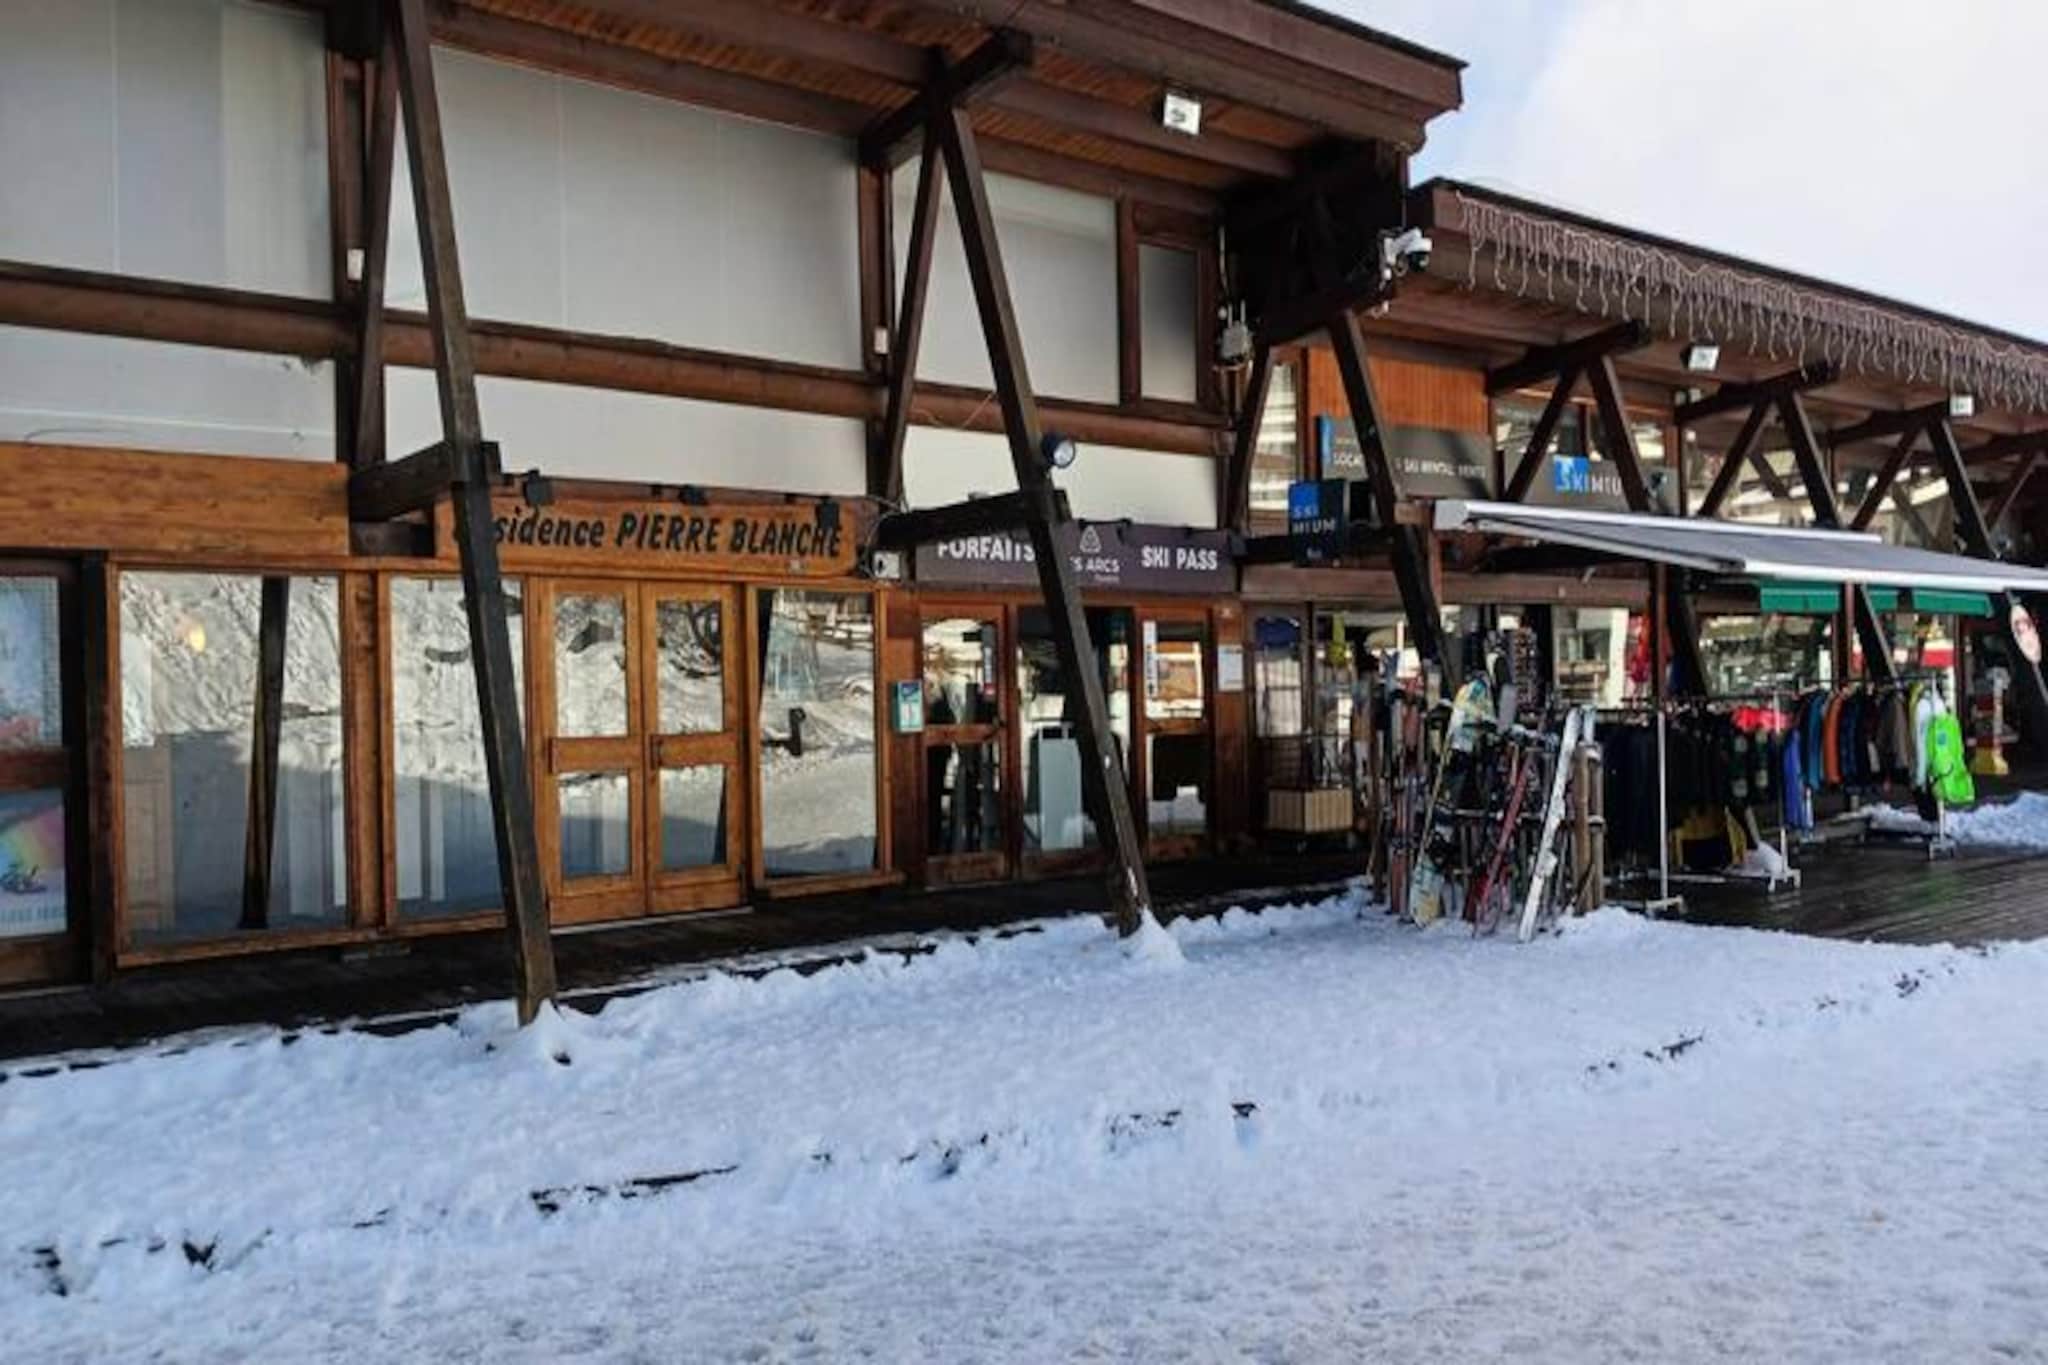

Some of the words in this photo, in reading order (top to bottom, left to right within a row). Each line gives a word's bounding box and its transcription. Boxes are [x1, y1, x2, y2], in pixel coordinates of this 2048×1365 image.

[1558, 470, 1622, 496] SKIMIU
[494, 505, 605, 548] sidence
[615, 511, 721, 553] PIERRE
[729, 518, 843, 558] BLANCHE
[1086, 558, 1120, 573] ARCS
[1141, 545, 1169, 568] SKI
[1176, 547, 1218, 571] PASS
